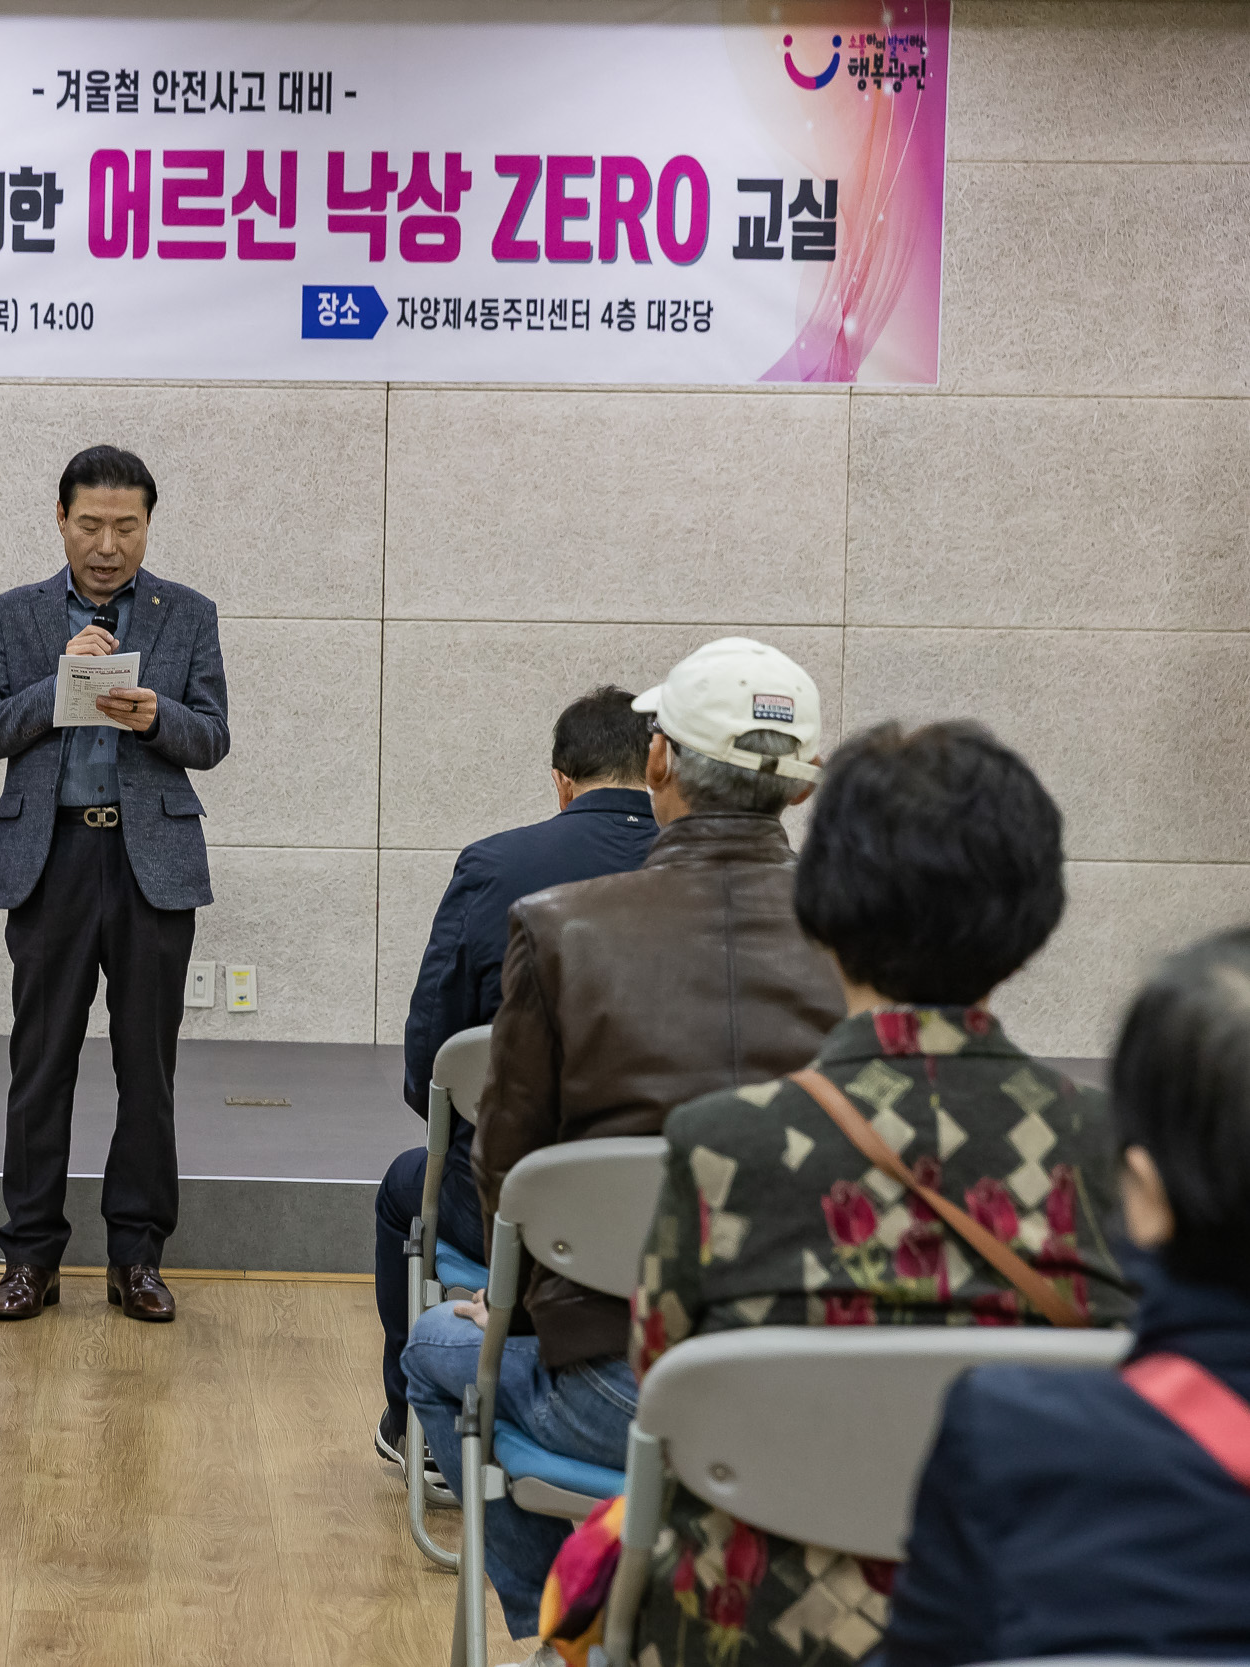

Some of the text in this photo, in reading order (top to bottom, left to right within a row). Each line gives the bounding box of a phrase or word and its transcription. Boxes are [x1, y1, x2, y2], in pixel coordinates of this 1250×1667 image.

[56, 69, 139, 113] 겨울철
[152, 70, 266, 114] 안전사고
[278, 70, 332, 114] 대비
[848, 53, 926, 93] 행복광진
[88, 148, 298, 261] 어르신
[327, 150, 472, 263] 낙상
[491, 154, 710, 266] ZERO
[732, 178, 838, 262] 교실
[30, 302, 94, 331] 14:00
[318, 292, 713, 333] 장소 자양제4동주민센터 4층 대강당
